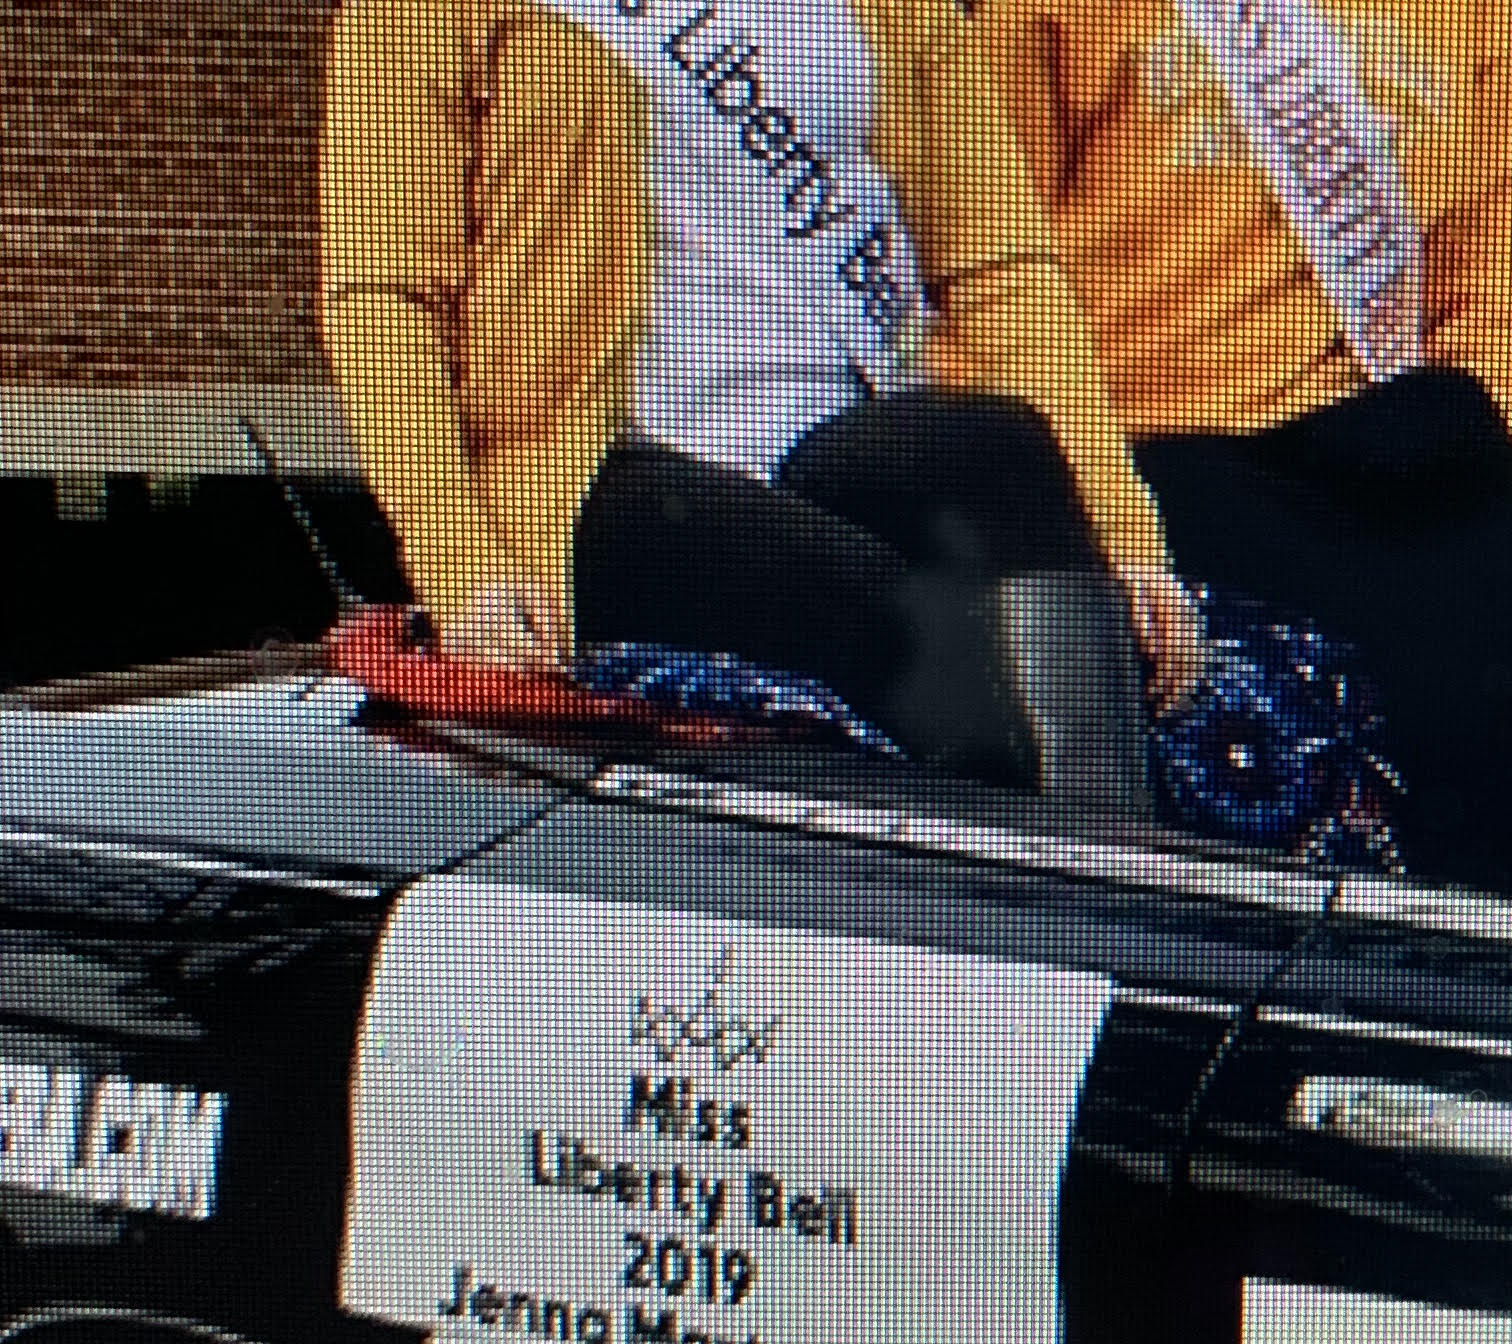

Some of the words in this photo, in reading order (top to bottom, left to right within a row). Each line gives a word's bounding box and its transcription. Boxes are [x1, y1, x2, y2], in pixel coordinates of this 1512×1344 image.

[663, 2, 856, 240] Liberty
[1249, 56, 1401, 269] LIBERTY
[624, 1071, 752, 1150] Miss
[525, 1129, 730, 1234] Liberty
[746, 1167, 859, 1248] Bell
[621, 1231, 758, 1307] 2019
